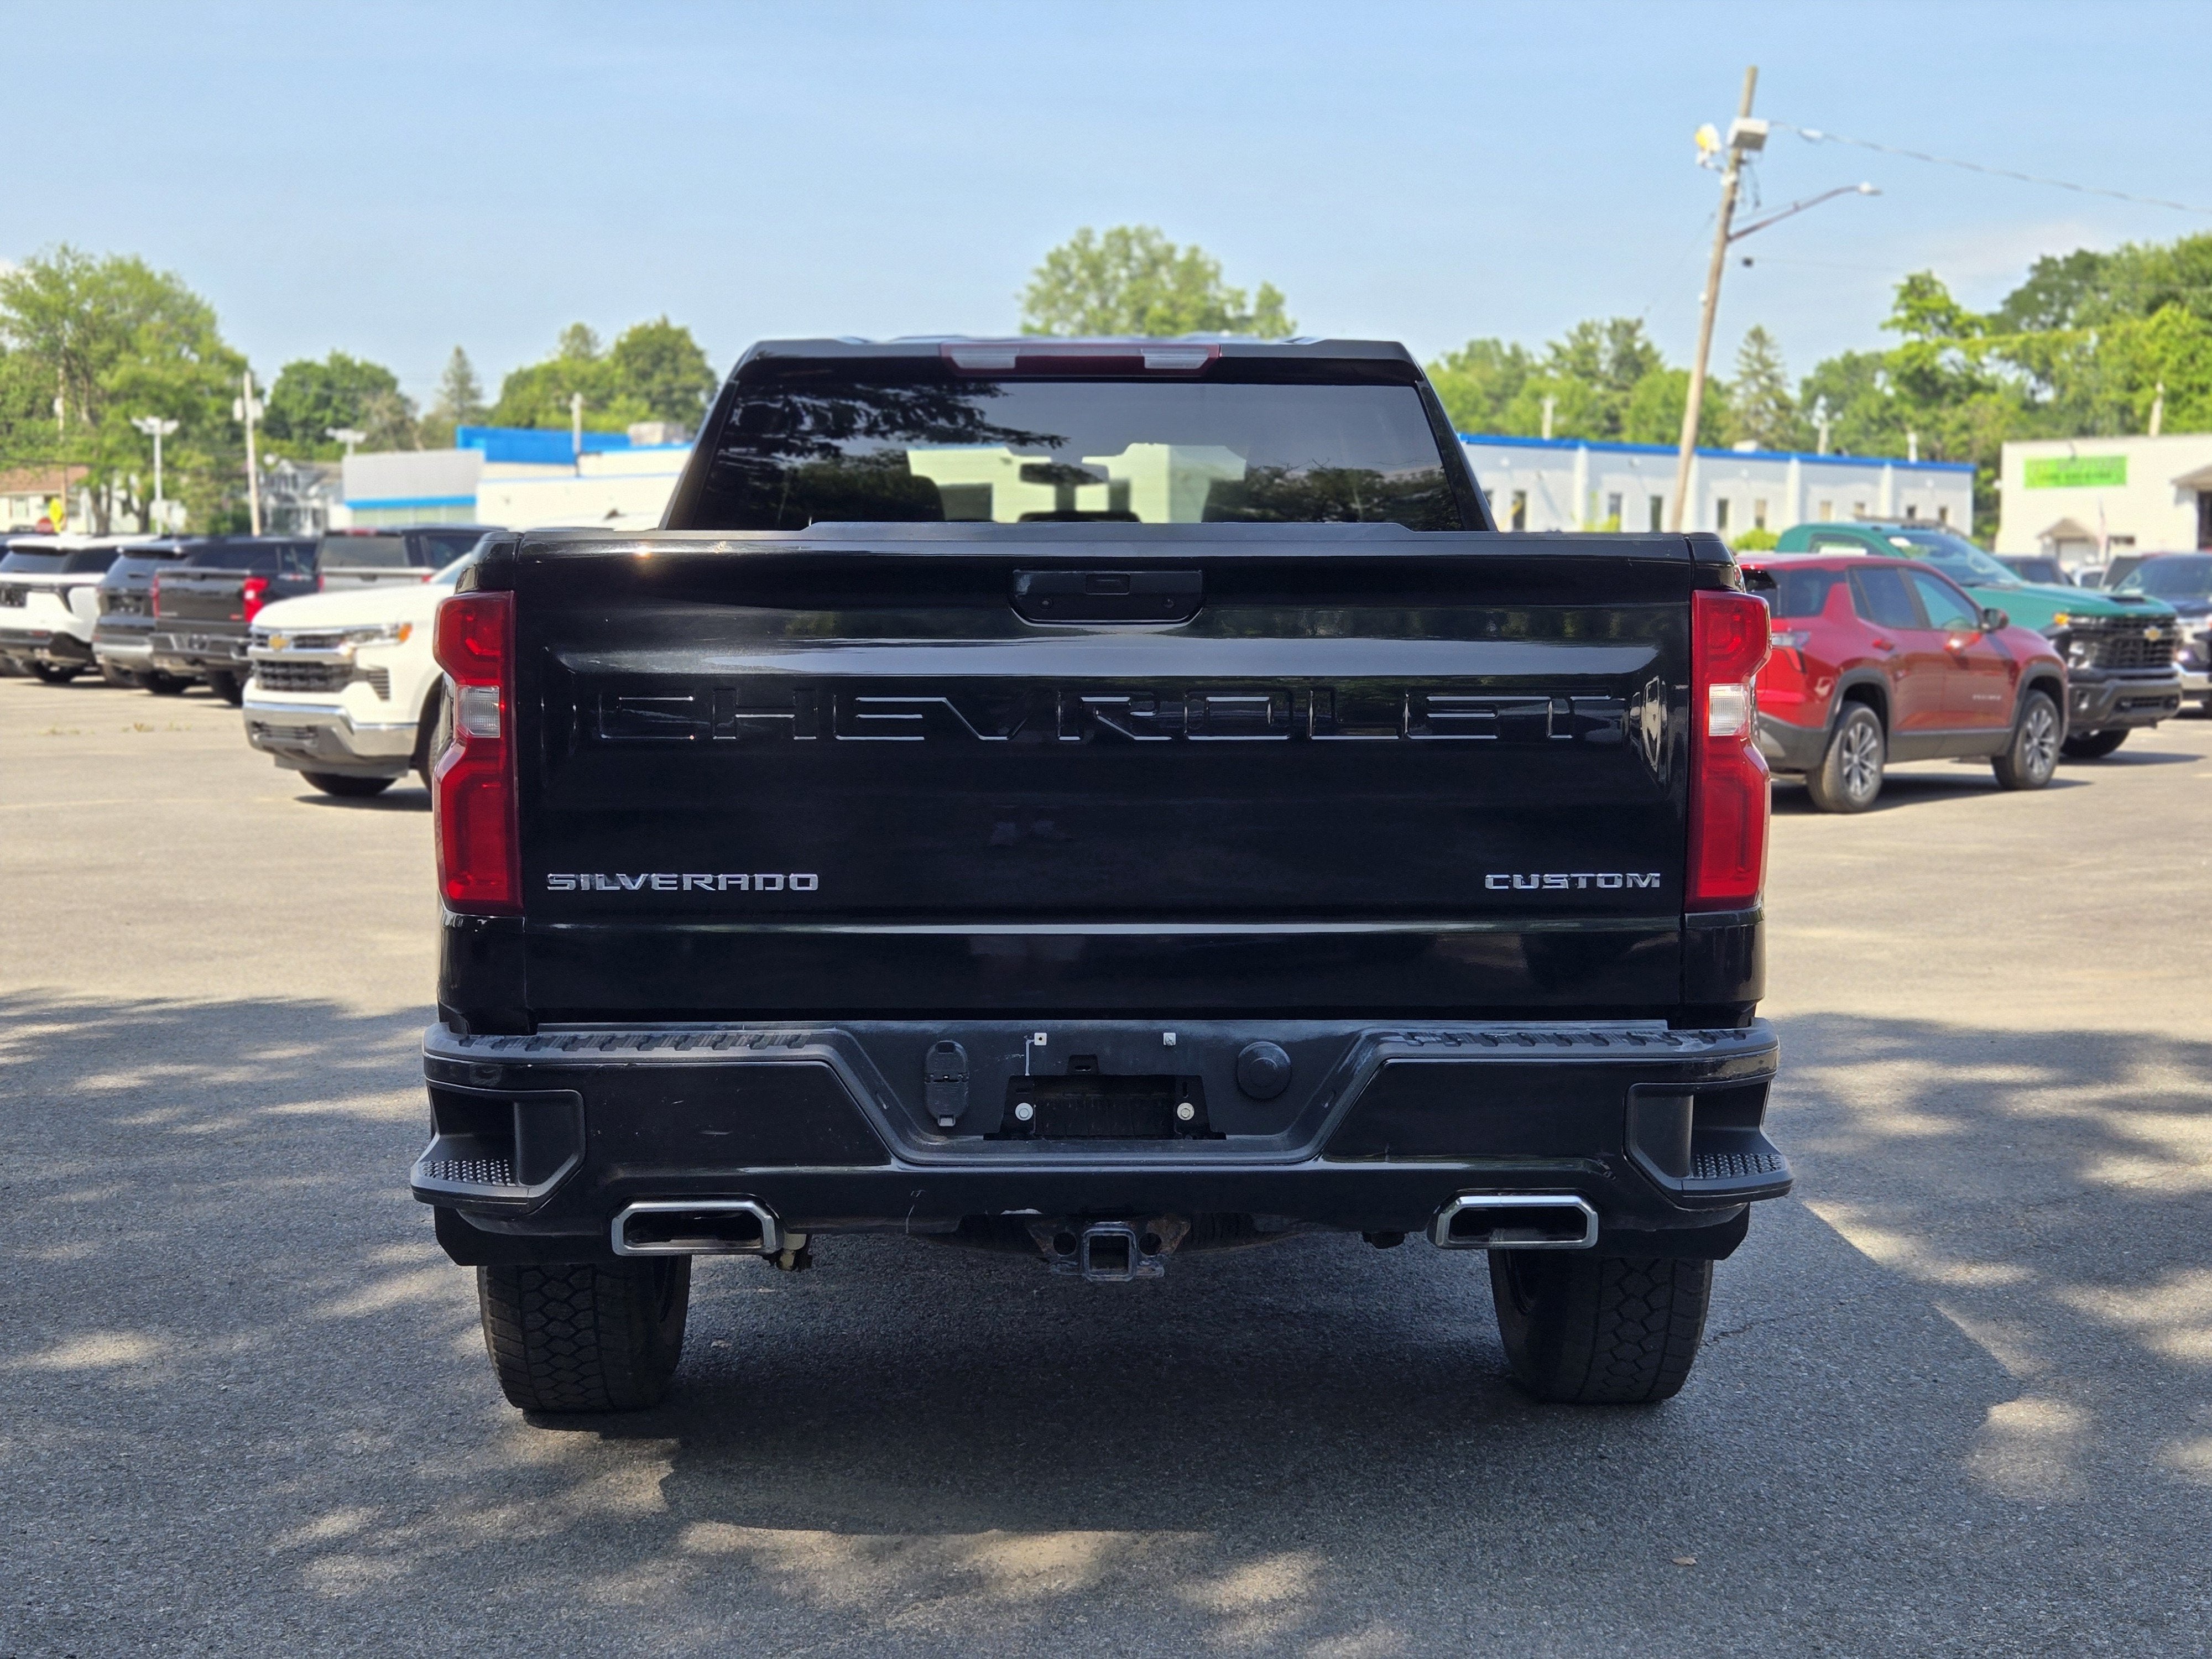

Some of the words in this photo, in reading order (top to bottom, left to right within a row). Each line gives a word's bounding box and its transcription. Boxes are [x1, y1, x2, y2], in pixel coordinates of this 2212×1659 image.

[598, 689, 1613, 740] CHEVROLET
[547, 873, 818, 891] SILVERADO
[1485, 873, 1661, 889] CUSTOM
